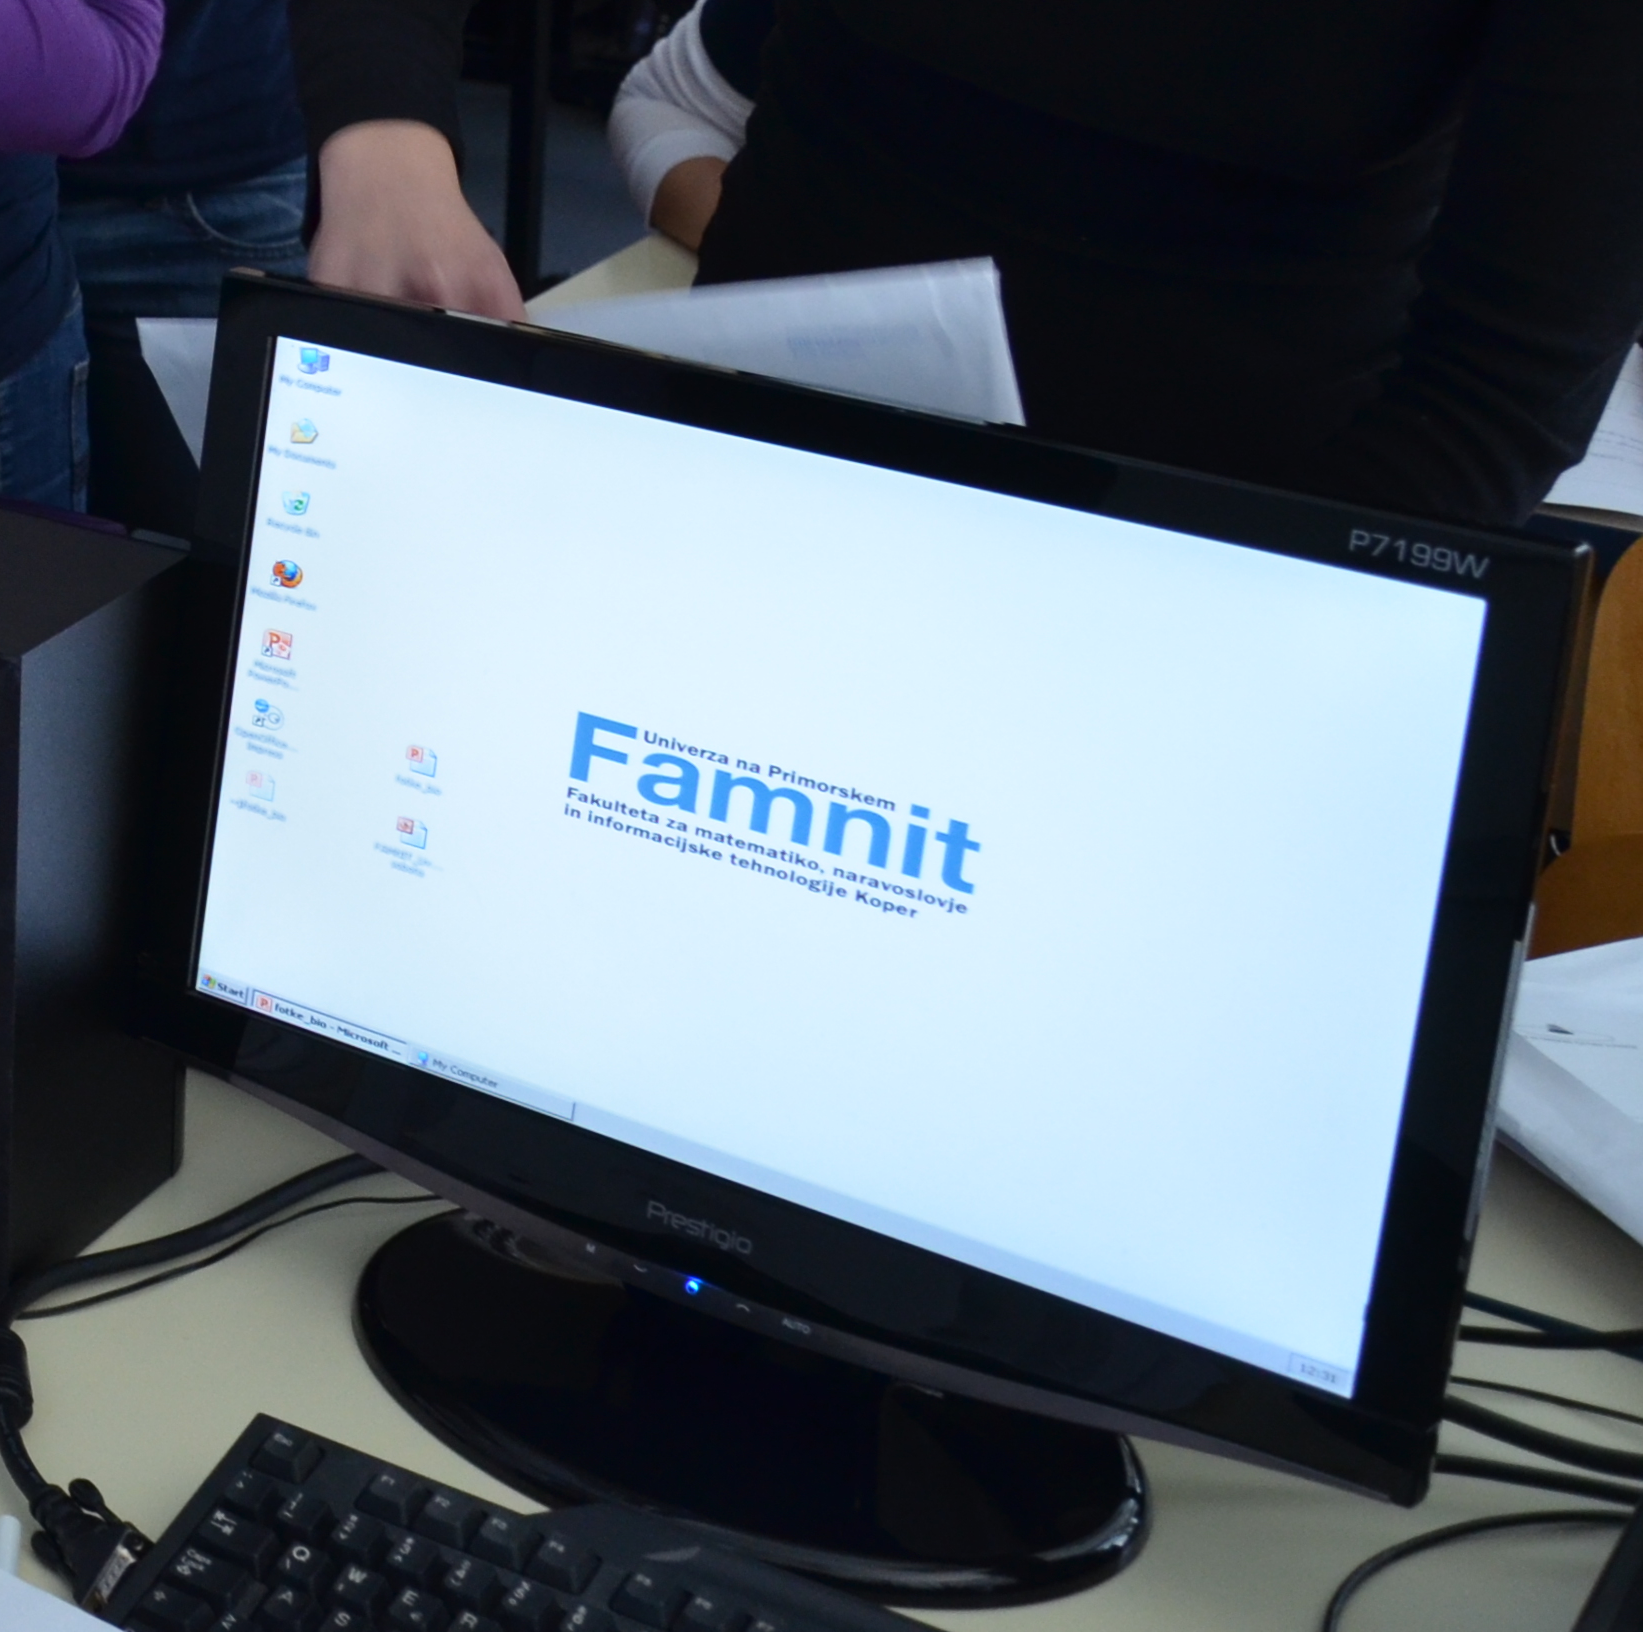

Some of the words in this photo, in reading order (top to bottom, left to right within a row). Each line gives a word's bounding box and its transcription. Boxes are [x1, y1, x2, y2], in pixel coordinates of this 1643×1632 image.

[1349, 529, 1490, 578] P7199W
[569, 710, 981, 895] Famnit
[643, 729, 729, 766] Univerza
[736, 758, 762, 775] na
[768, 764, 897, 812] Primorskem
[564, 802, 581, 819] in
[587, 809, 723, 862] informacijske
[729, 852, 848, 898] tehnologije
[854, 889, 919, 919] Koper
[566, 785, 661, 825] Fakulteta
[666, 817, 689, 833] za
[695, 825, 825, 874] matematiko,
[832, 866, 969, 915] naravoslovje
[217, 982, 244, 1000] Start
[337, 1024, 390, 1052] Microsoft
[432, 1058, 447, 1072] My
[449, 1064, 499, 1089] Computer
[646, 1200, 754, 1256] Prestigio
[781, 1317, 811, 1335] AUTO
[292, 1545, 311, 1563] Q
[347, 1567, 366, 1585] W
[402, 1589, 420, 1606] E
